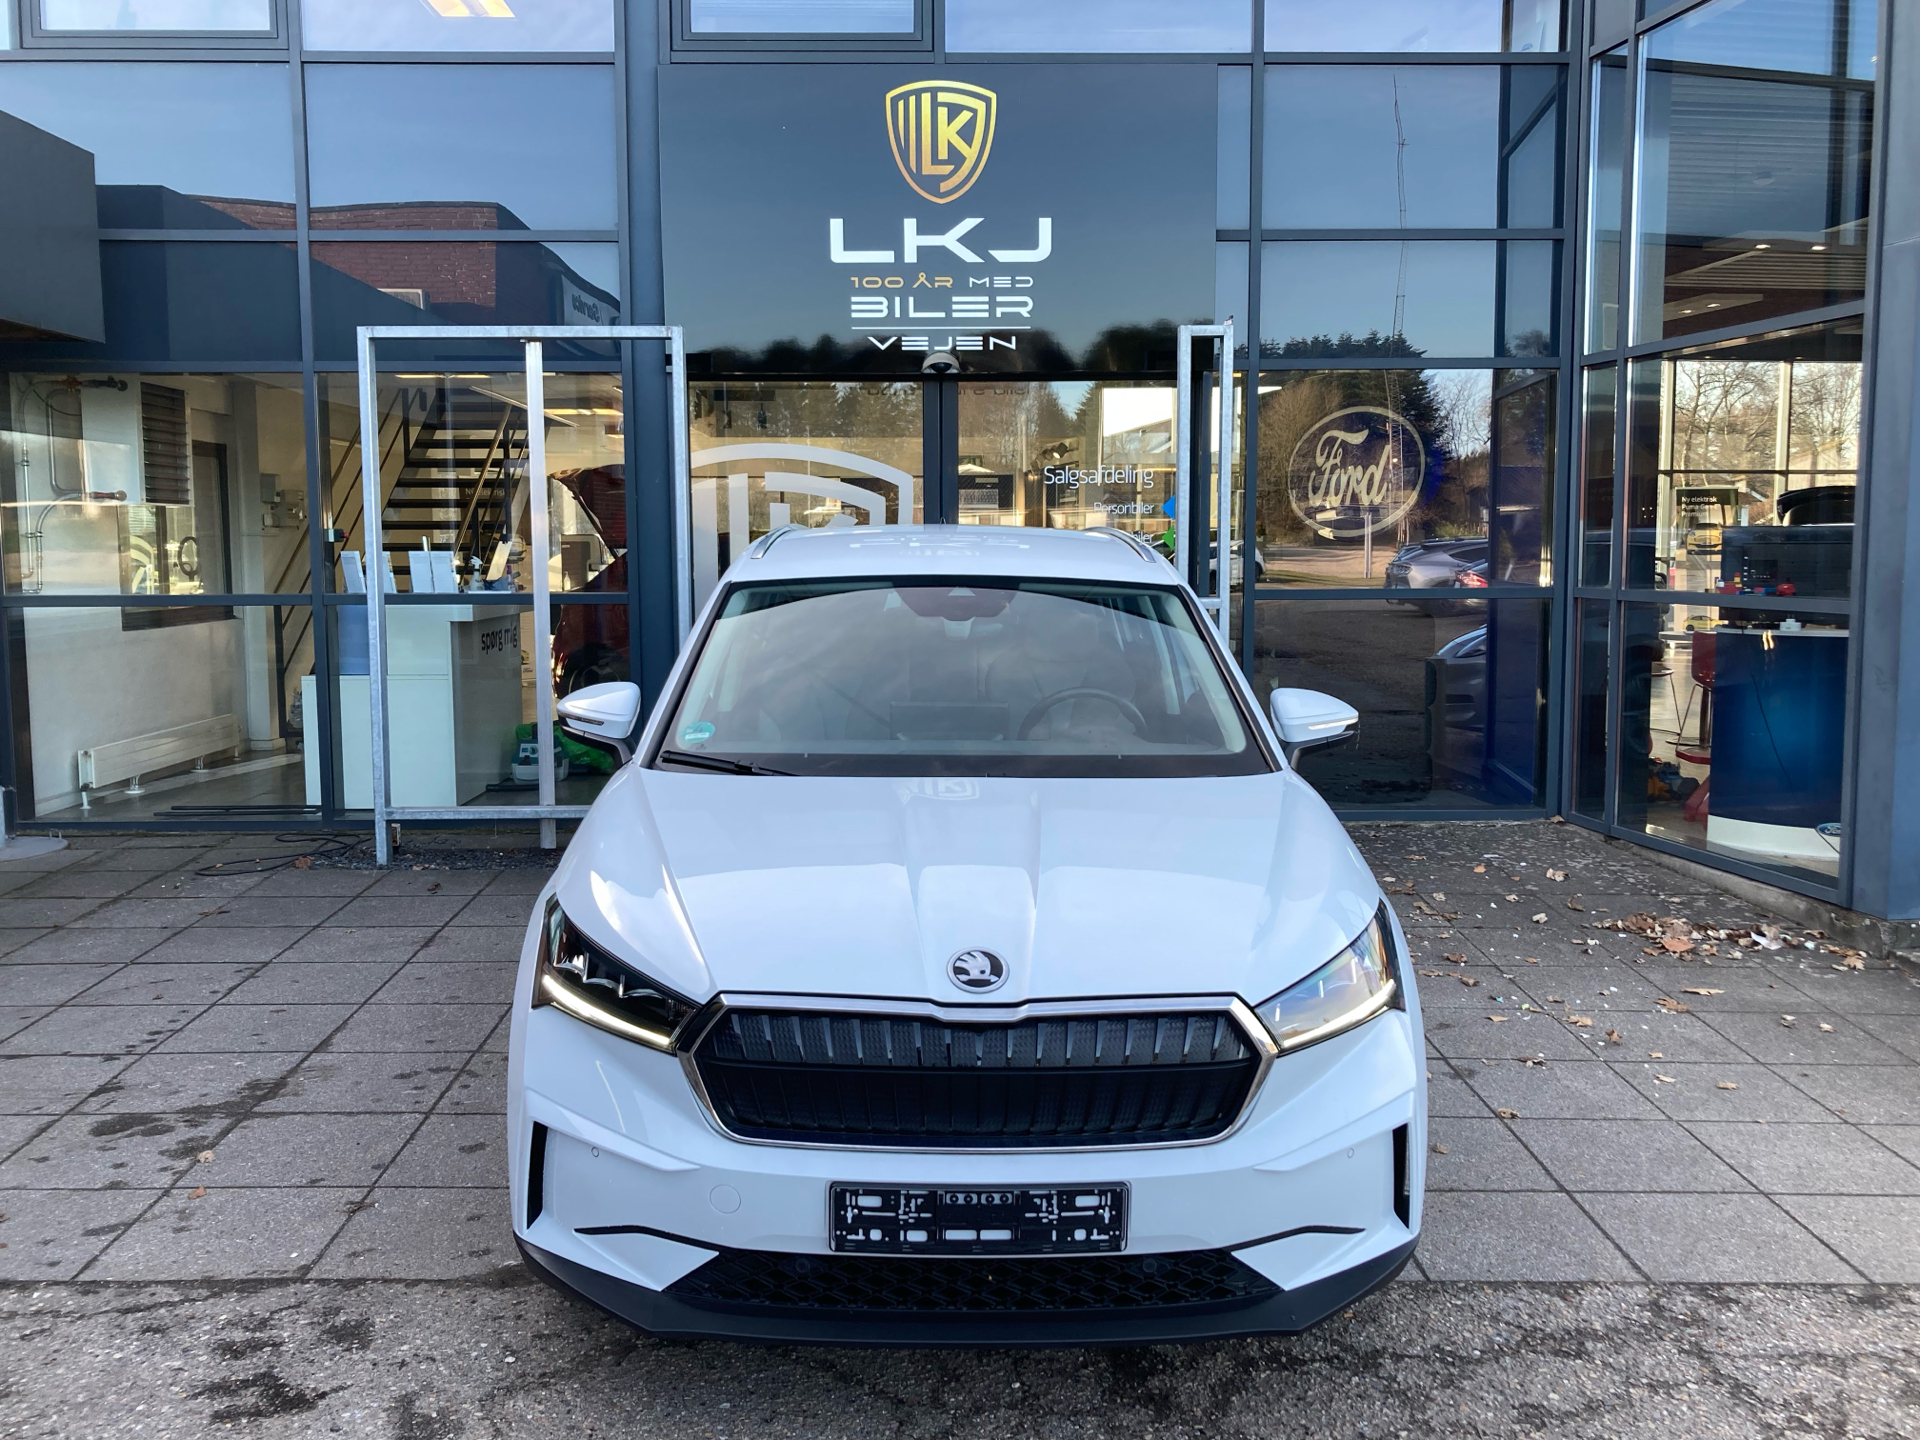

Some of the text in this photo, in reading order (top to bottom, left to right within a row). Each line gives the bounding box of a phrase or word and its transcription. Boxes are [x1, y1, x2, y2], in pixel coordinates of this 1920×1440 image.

[830, 217, 1052, 263] LKJ
[851, 272, 1034, 288] 100 ÅR MED
[851, 296, 1034, 318] BILER
[867, 335, 1016, 350] VEJEN
[1044, 465, 1154, 489] Salgsafdeling
[1308, 429, 1387, 507] Ford
[1093, 502, 1154, 515] Personbiler
[481, 628, 503, 654] spørg
